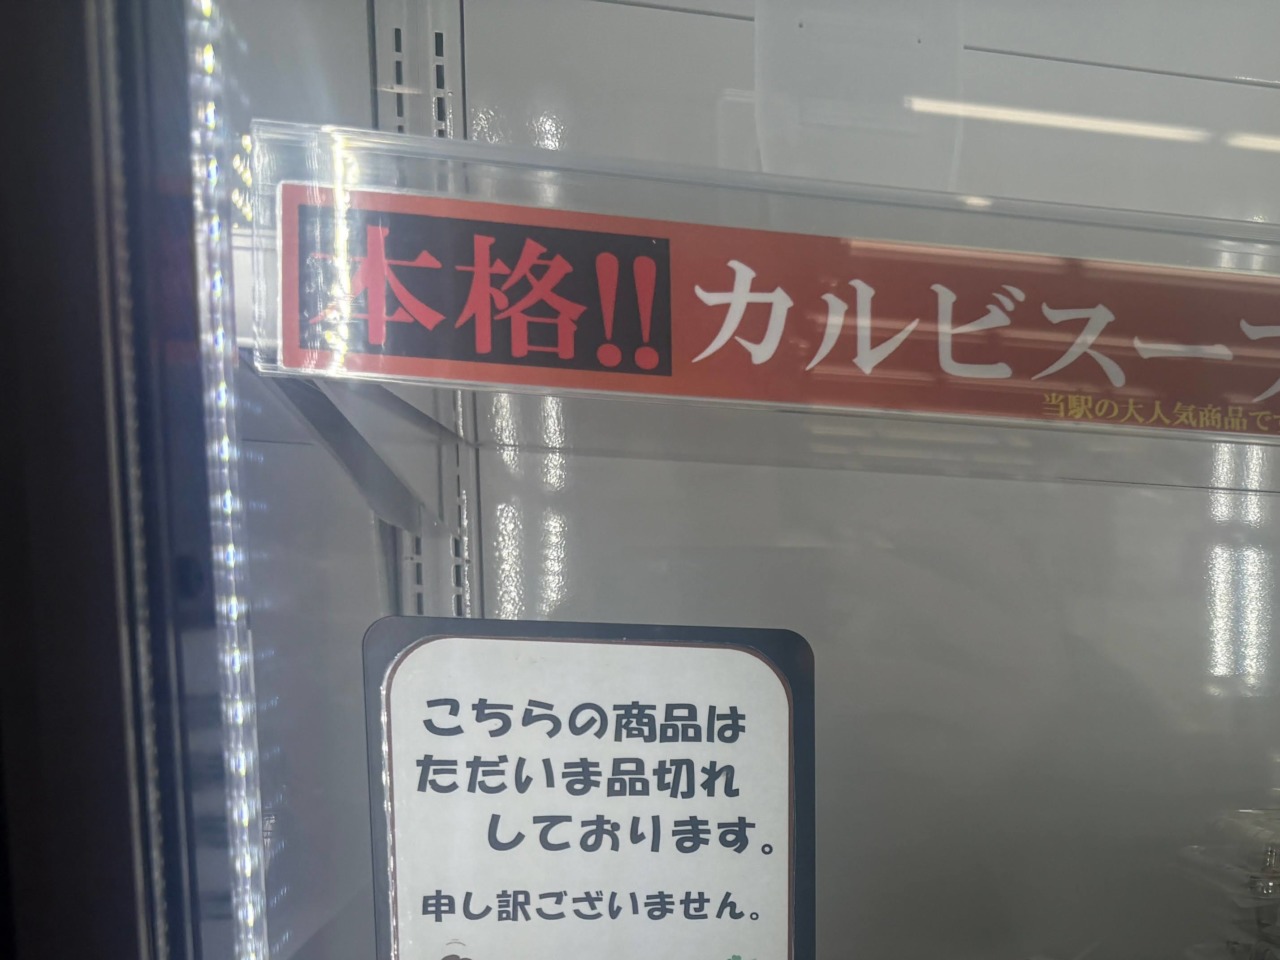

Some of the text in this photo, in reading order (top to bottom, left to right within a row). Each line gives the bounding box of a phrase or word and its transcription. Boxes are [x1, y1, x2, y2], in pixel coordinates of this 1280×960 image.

[422, 697, 747, 744] こちらの商品は
[415, 754, 740, 799] ただいま品切れ
[486, 813, 775, 856] しております。
[421, 889, 760, 923] 申し訳ございません。
